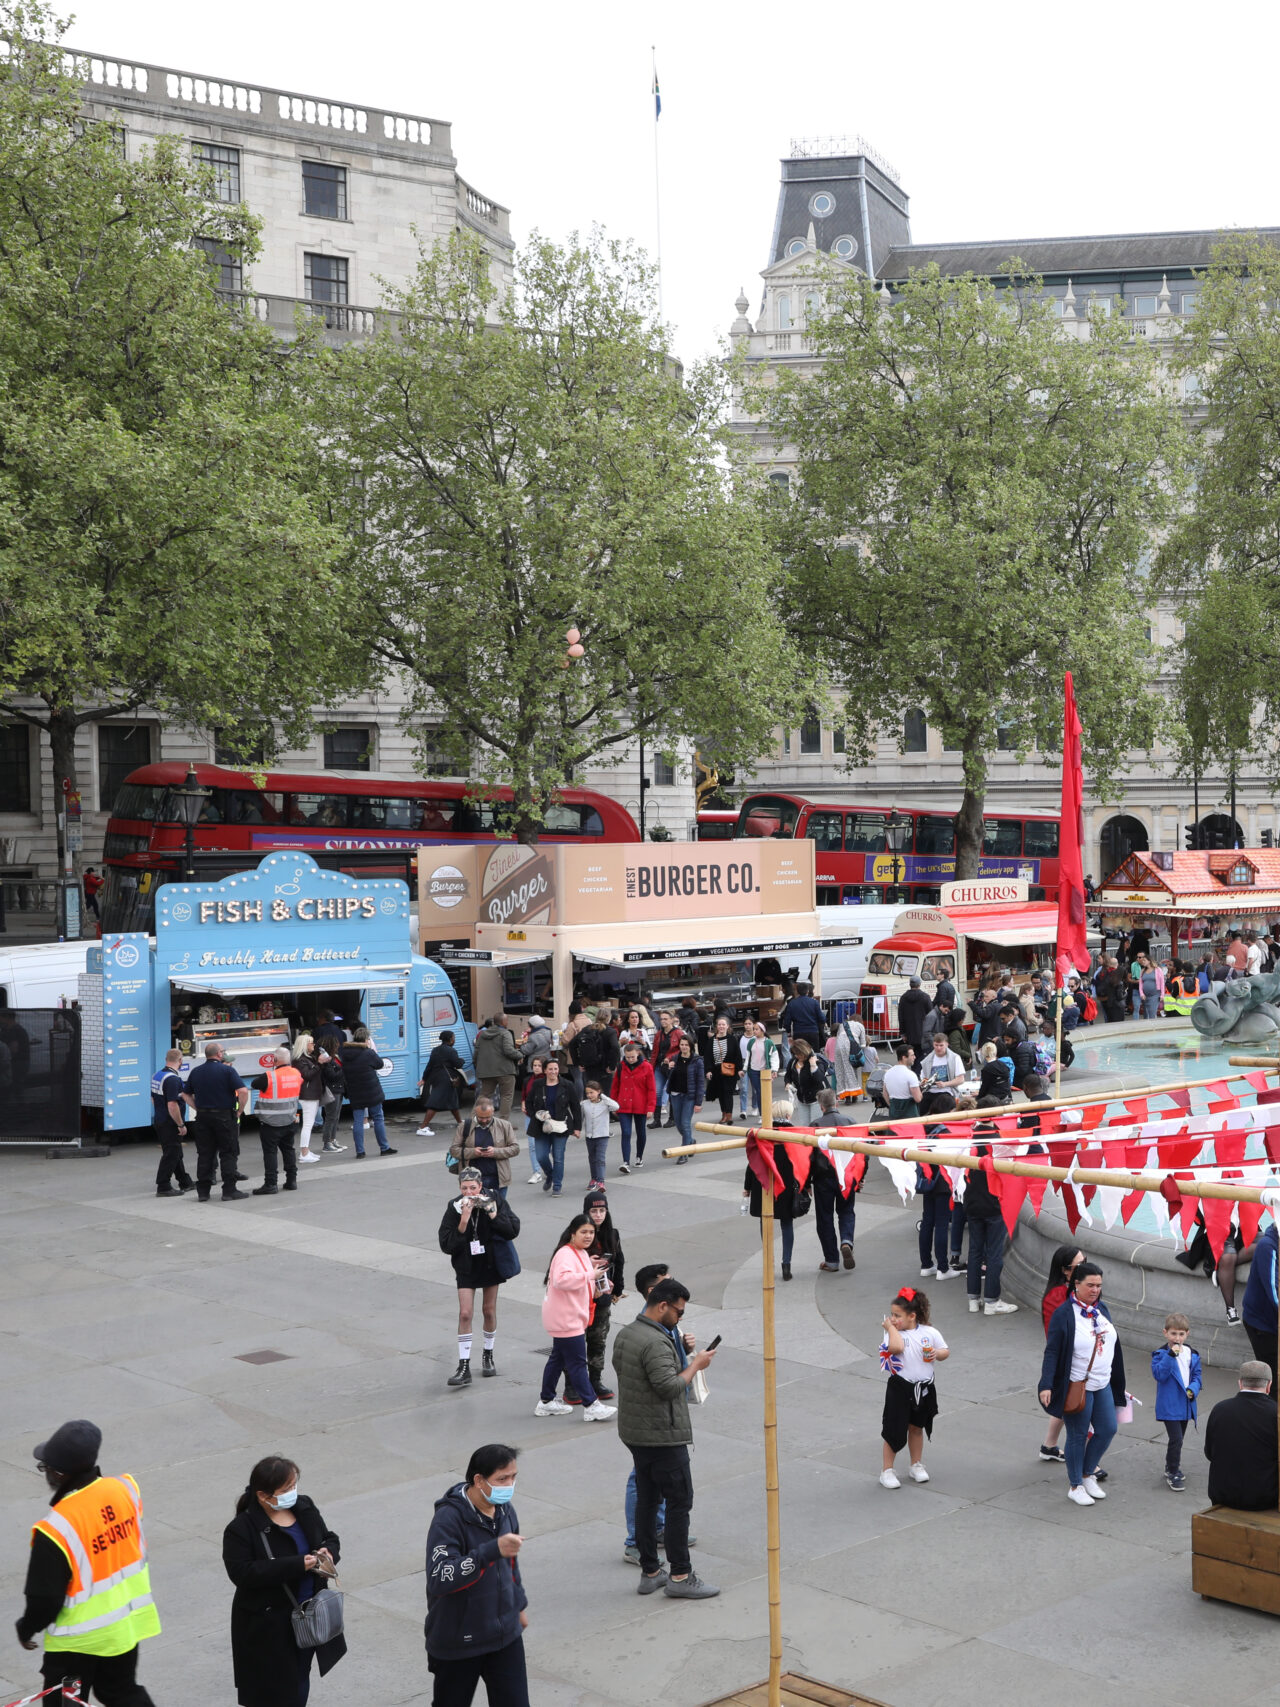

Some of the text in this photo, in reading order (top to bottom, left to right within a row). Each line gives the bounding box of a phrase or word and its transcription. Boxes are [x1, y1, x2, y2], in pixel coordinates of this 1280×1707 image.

[490, 848, 520, 882] Finest
[980, 865, 1001, 875] delivery
[1003, 866, 1014, 875] app
[430, 881, 465, 893] Burger
[626, 867, 636, 898] FINEST
[638, 862, 761, 897] BURGER CO.
[816, 875, 835, 883] ARRIVA
[489, 873, 547, 924] Burger
[952, 885, 1018, 902] CHURROS
[200, 897, 376, 923] FISH & CHIPS
[906, 911, 942, 922] CHURROS
[200, 946, 360, 968] Freshly Hand Battered
[710, 947, 744, 955] VEGETARIAN
[101, 1505, 116, 1525] SB
